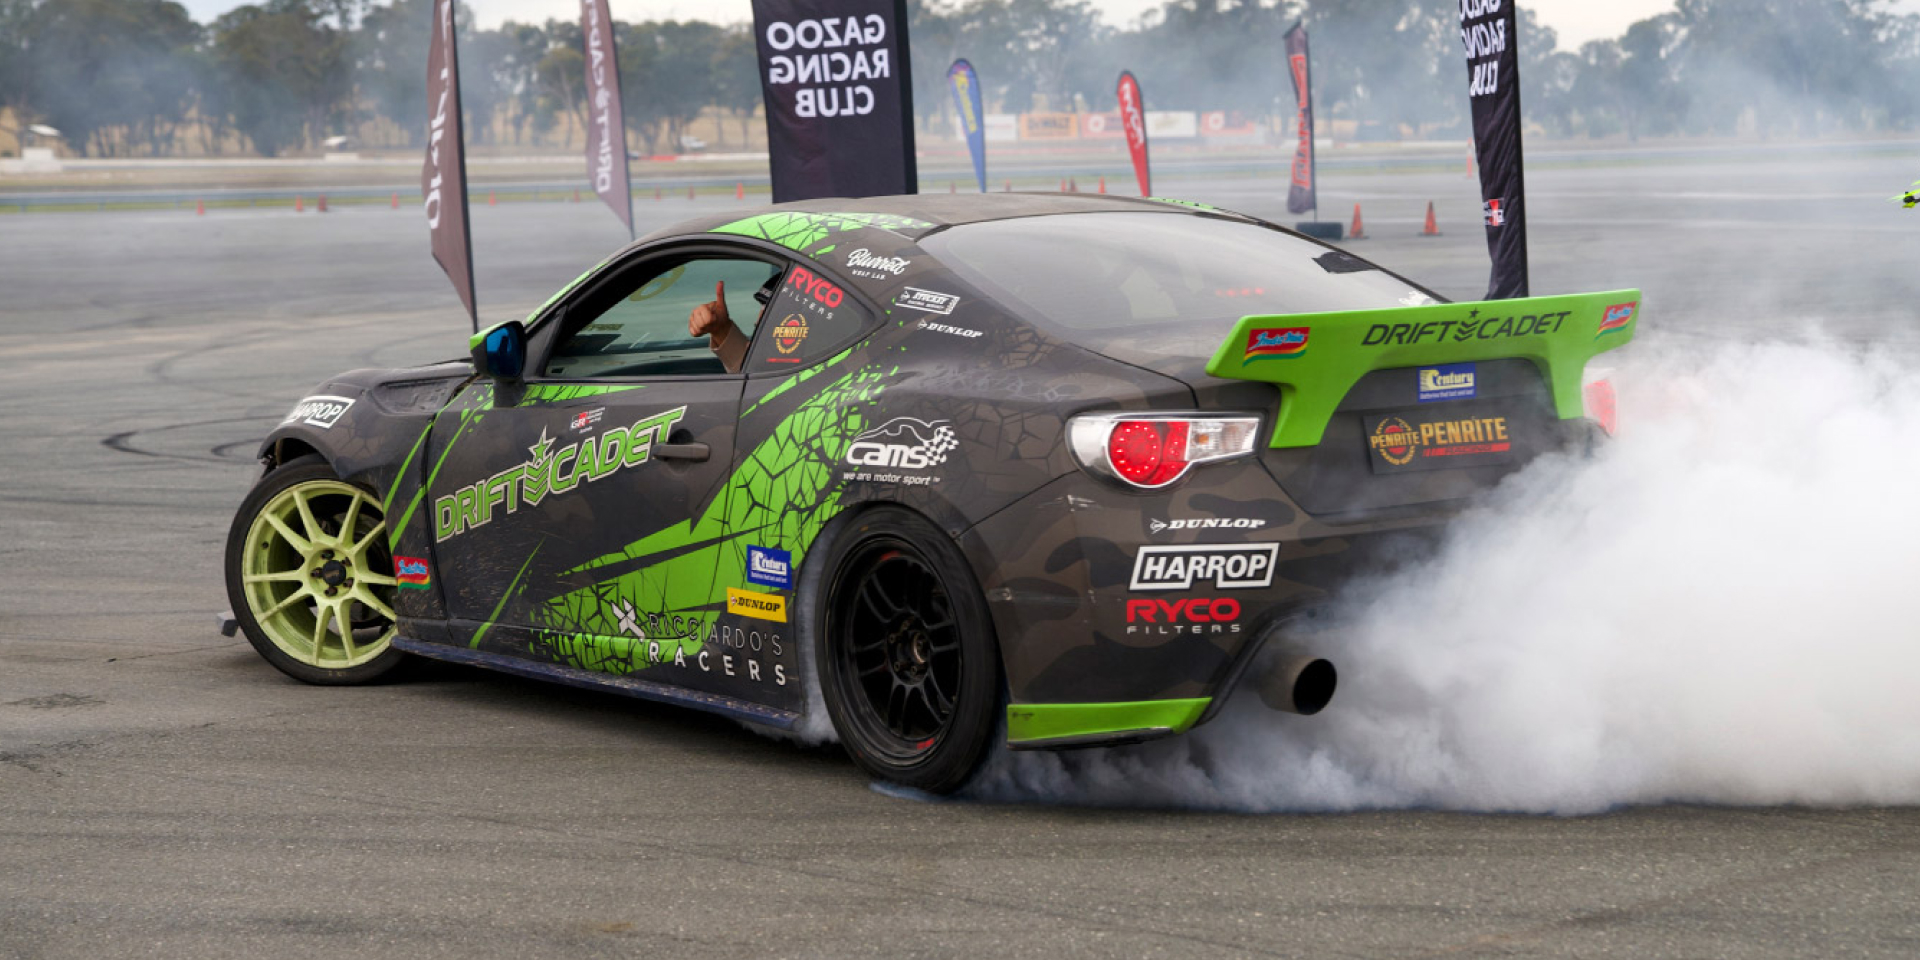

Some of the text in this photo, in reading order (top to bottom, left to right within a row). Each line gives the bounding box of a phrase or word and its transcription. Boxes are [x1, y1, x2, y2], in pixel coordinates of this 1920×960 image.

[846, 248, 911, 275] Blurred
[788, 266, 844, 308] RYCO
[782, 287, 834, 320] FILTERS
[772, 327, 809, 337] PENRITE
[927, 322, 983, 338] DUNLOP
[1361, 311, 1572, 345] DRIFT CADET
[1420, 370, 1474, 392] Century
[1370, 432, 1420, 449] PENRITE
[1419, 417, 1508, 446] PENRITE
[436, 405, 687, 543] DRIFT CADET
[843, 472, 856, 480] we
[857, 473, 872, 481] are
[874, 473, 902, 483] motor
[903, 475, 931, 486] sport
[1168, 518, 1266, 530] DUNLOP
[1143, 554, 1268, 581] HARROP
[736, 597, 781, 612] DUNLOP
[1126, 597, 1241, 623] RYCO
[649, 613, 782, 656] RICCIARDO'S
[1126, 624, 1241, 634] FILTERS
[649, 641, 786, 686] RACERS
